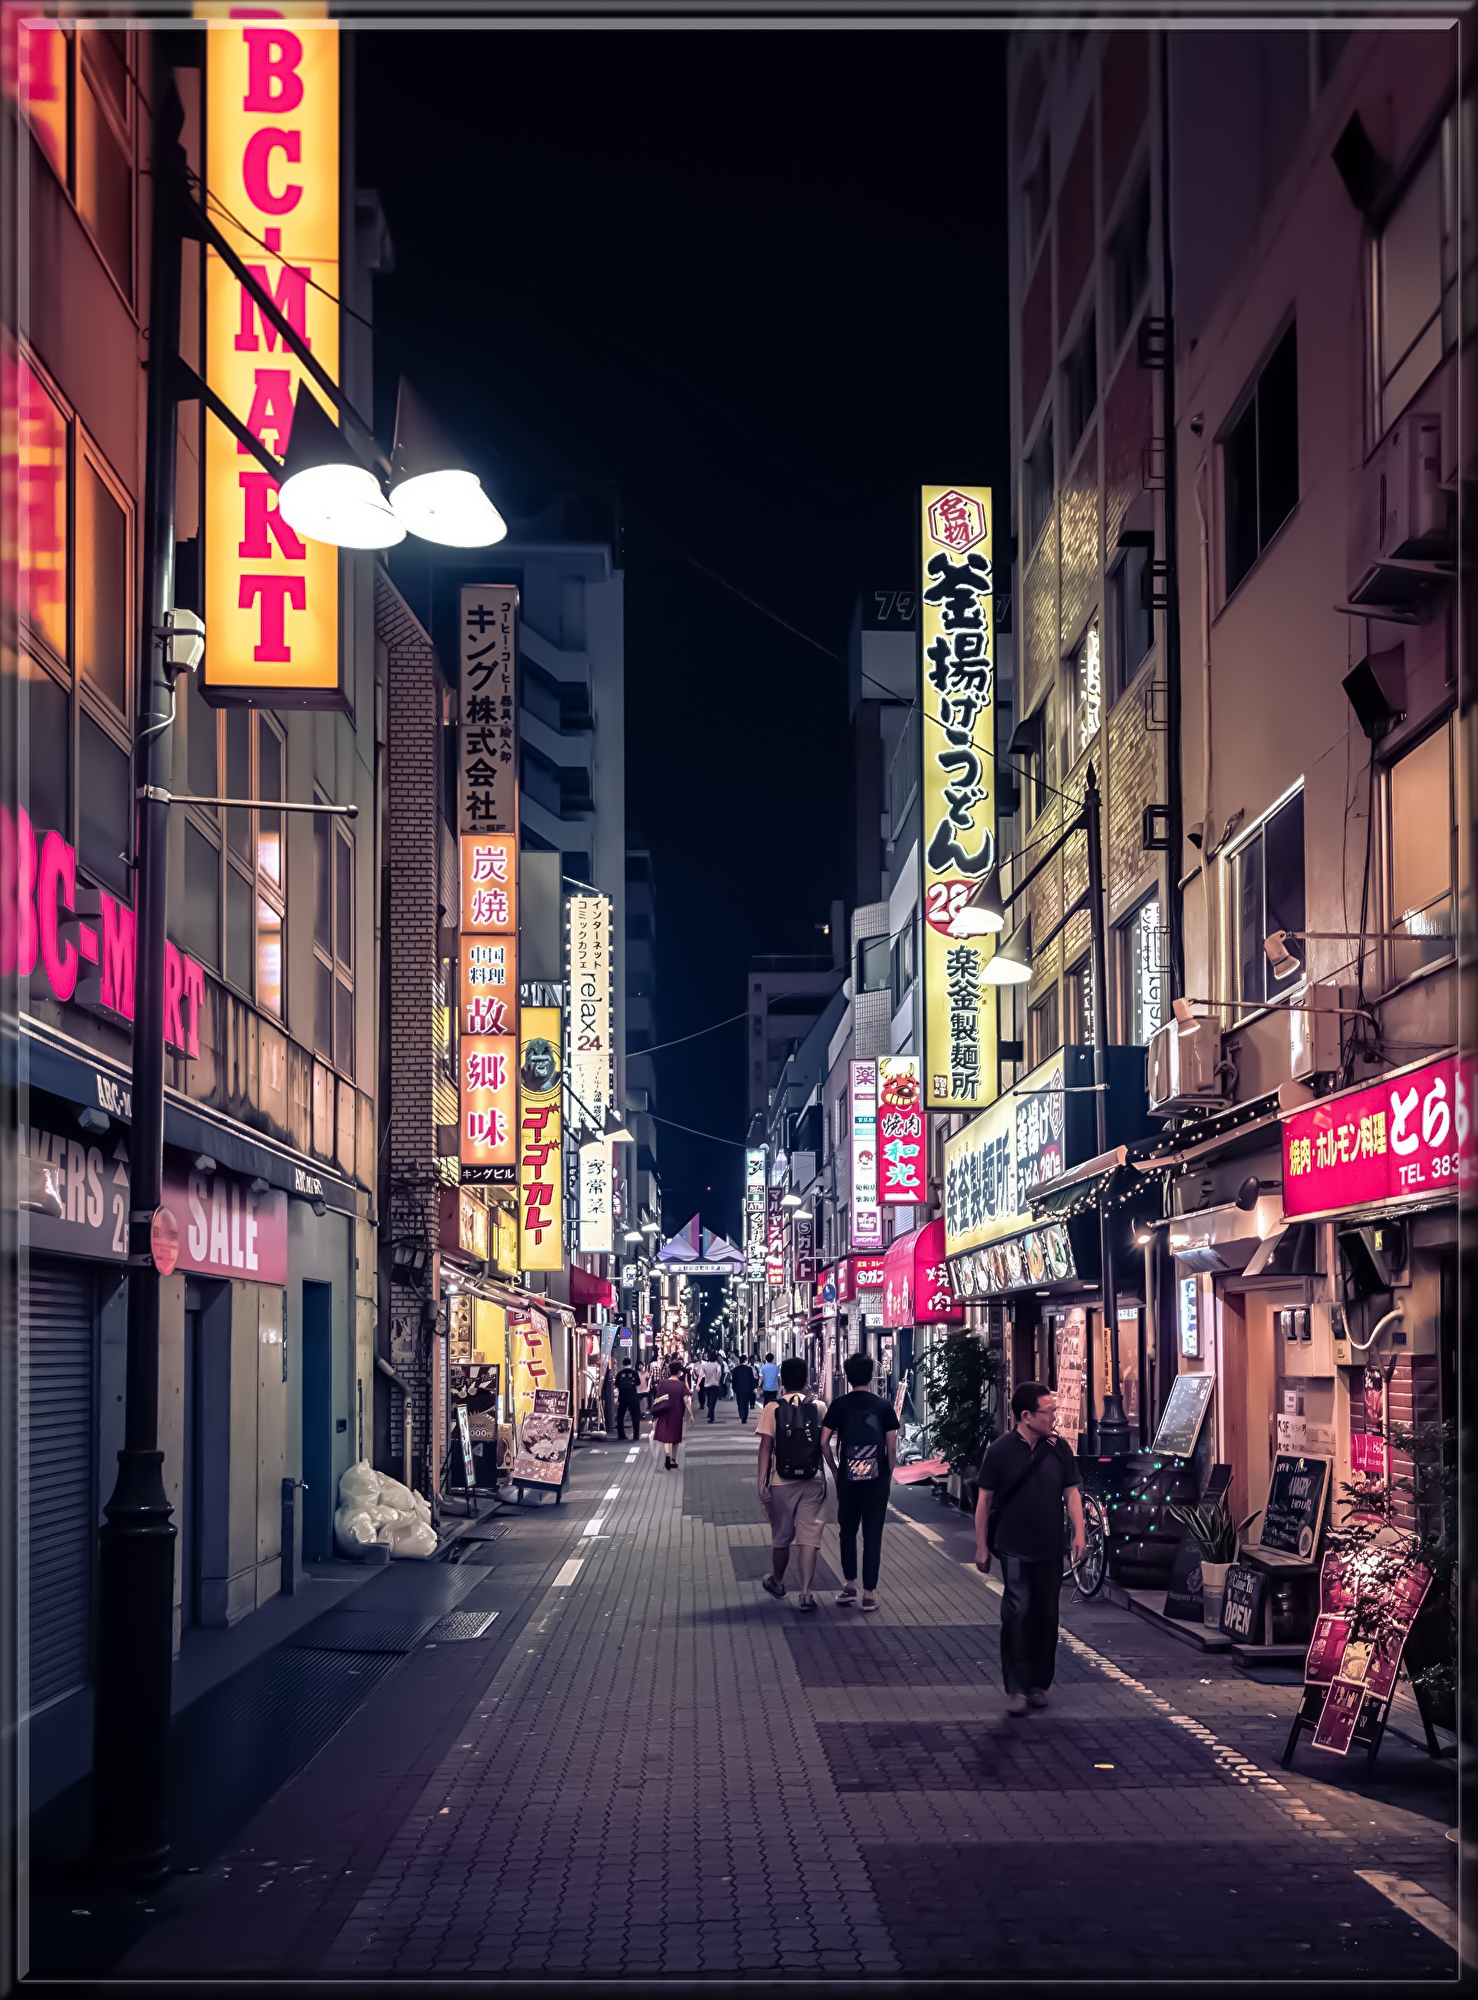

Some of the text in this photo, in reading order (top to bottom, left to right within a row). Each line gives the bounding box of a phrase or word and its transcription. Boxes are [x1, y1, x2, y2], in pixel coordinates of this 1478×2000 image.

[466, 605, 498, 820] キング株式会社
[924, 552, 993, 877] 釜揚げうどん
[472, 847, 508, 925] 炭焼
[578, 901, 588, 969] コミックカフェ
[592, 900, 602, 970] インターネット
[470, 967, 506, 985] 料理
[581, 973, 602, 1034] relax
[577, 1035, 602, 1051] 24
[947, 945, 982, 1099] 楽釜製麺所
[467, 997, 508, 1148] 故郷味
[882, 1113, 921, 1137] 焼肉
[1290, 1111, 1387, 1176] 焼肉・ホルモン料理
[462, 1168, 514, 1180] キングビル
[522, 1101, 562, 1246] ゴーゴーカレー
[586, 1158, 606, 1214] 家常菜
[883, 1139, 921, 1187] 和光
[1399, 1163, 1425, 1185] TEL
[188, 1171, 258, 1270] SALE
[1224, 1600, 1252, 1636] OPEN
